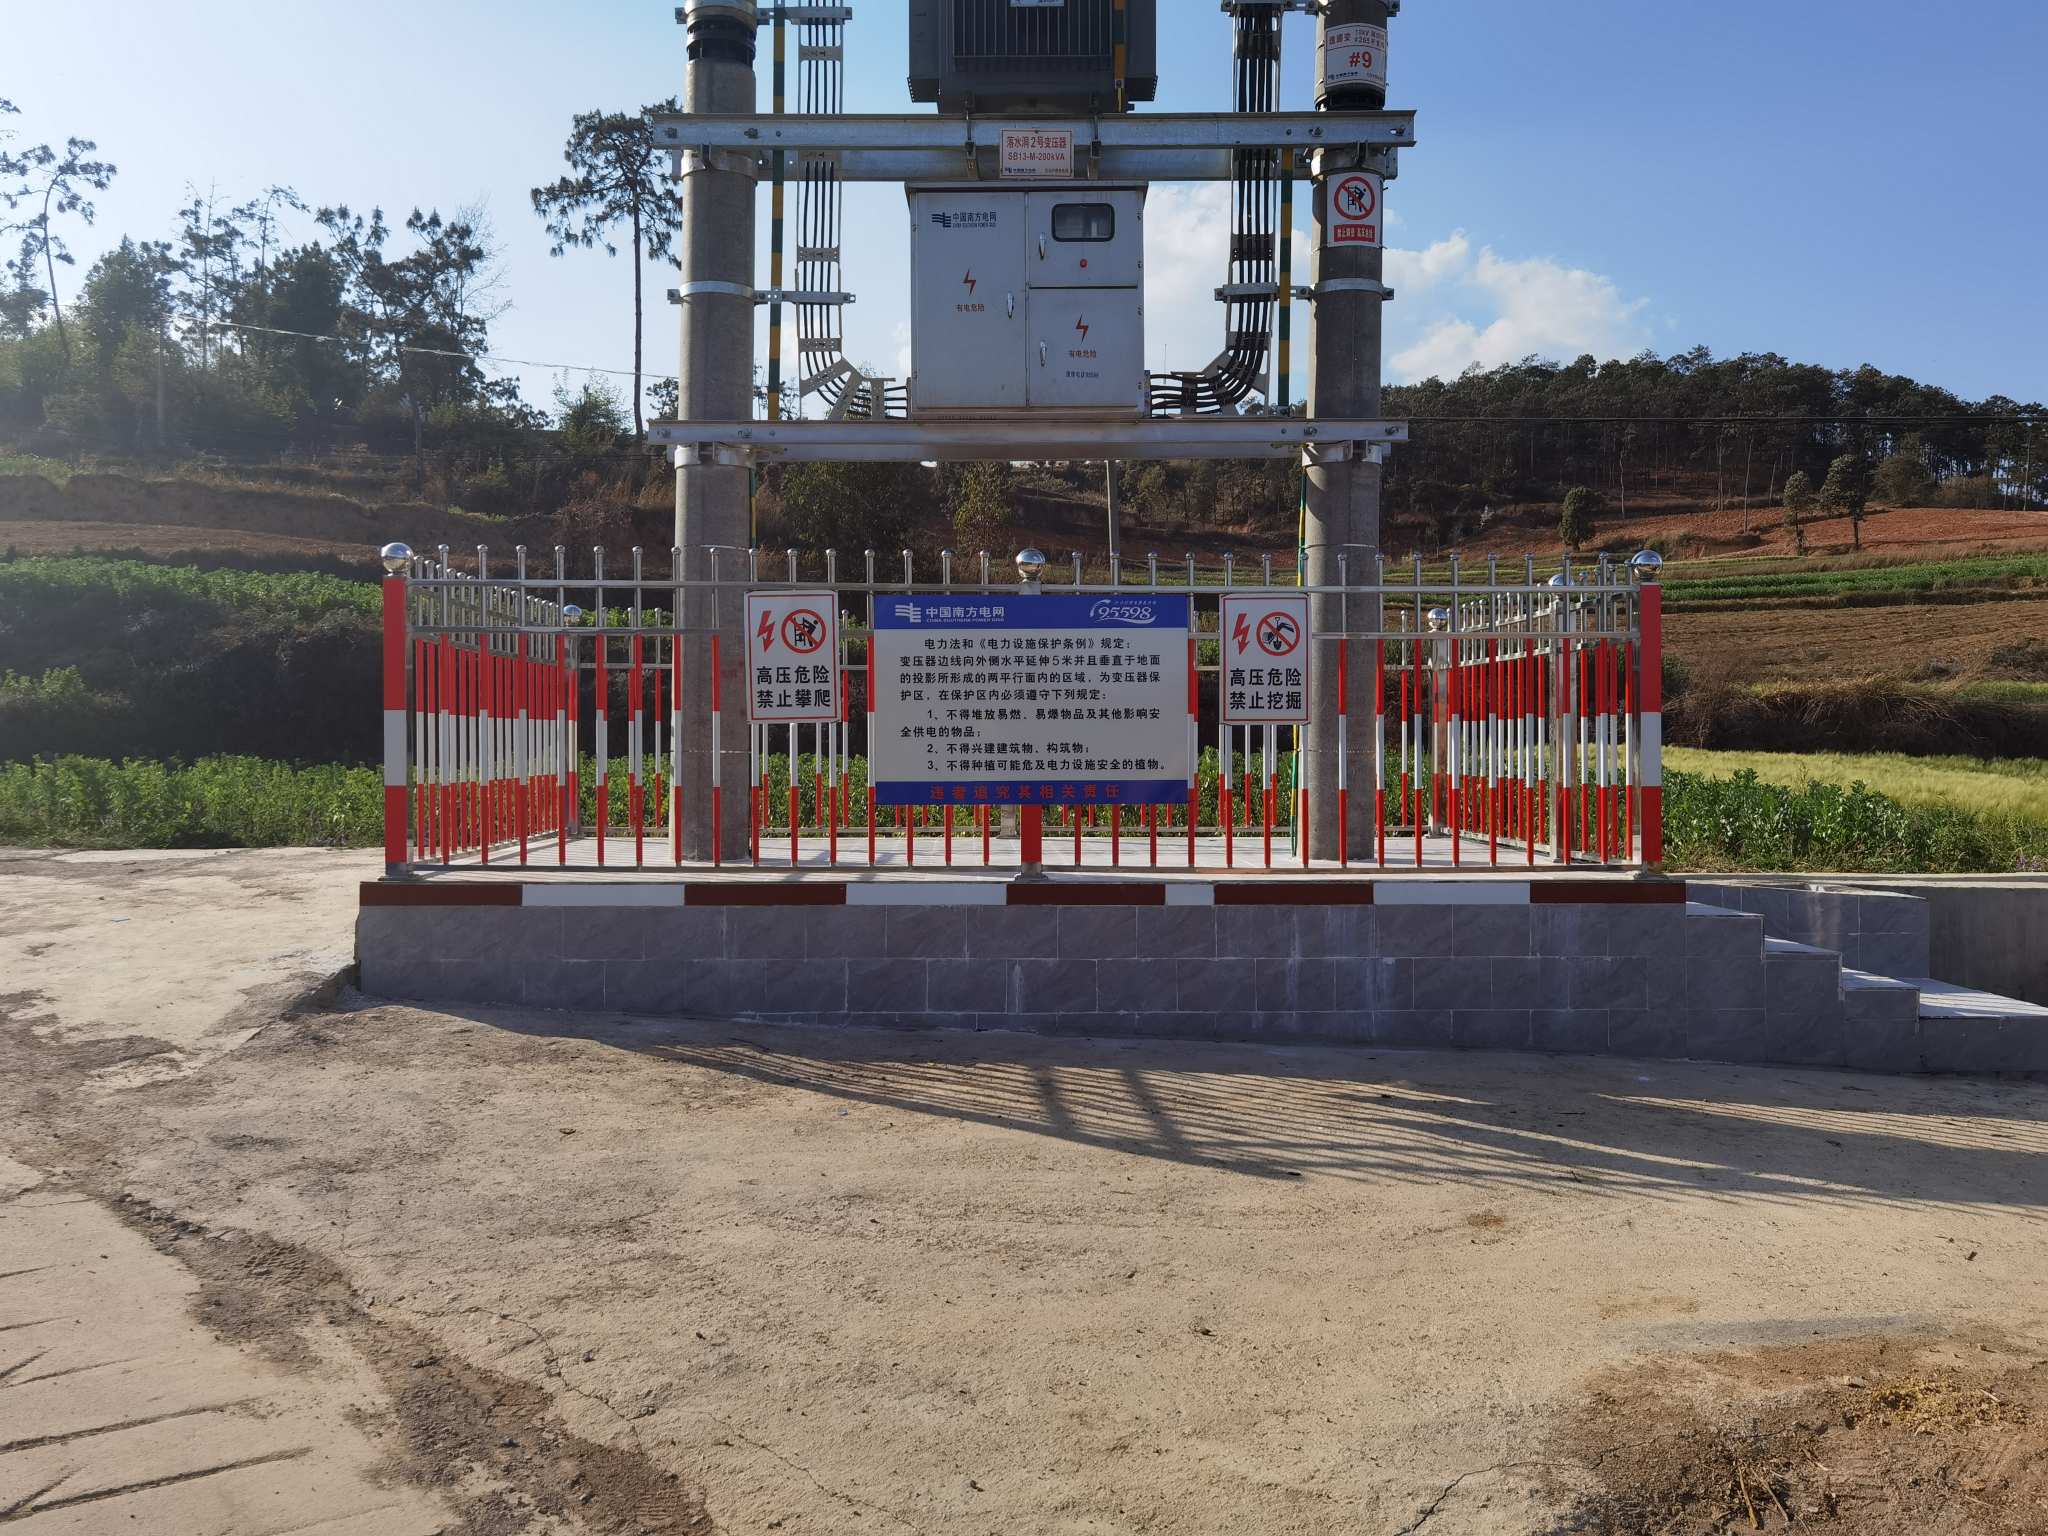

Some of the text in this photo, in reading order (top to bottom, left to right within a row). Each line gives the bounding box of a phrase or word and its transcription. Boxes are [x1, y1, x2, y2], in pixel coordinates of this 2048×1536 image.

[1349, 51, 1373, 69] #9
[952, 211, 997, 222] 中国南方电网
[926, 606, 1005, 618] 中国南方电网
[1098, 606, 1152, 620] 95598
[900, 655, 1161, 667] 变压器边线向外侧水平延伸5米并且垂直于地面
[757, 665, 830, 685] 高压危险
[1230, 667, 1302, 687] 高压危险
[757, 688, 831, 708] 禁止攀爬
[1230, 691, 1302, 710] 禁止挖掘
[930, 785, 1120, 799] 违者追究其相关责任
